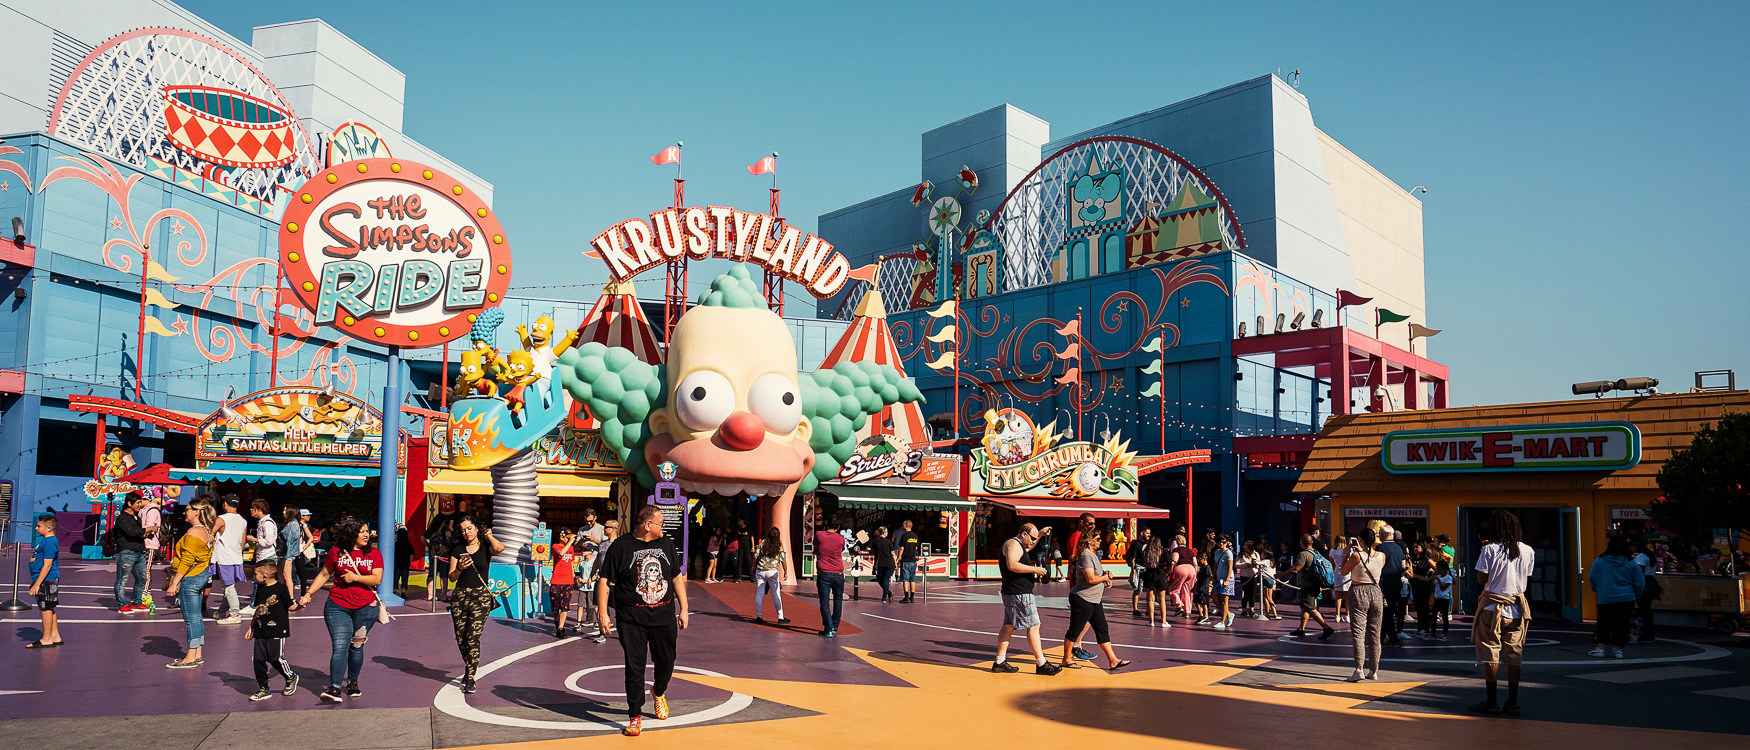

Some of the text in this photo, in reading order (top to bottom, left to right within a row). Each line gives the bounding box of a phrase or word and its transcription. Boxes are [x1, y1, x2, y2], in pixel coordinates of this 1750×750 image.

[667, 147, 677, 161] K
[764, 158, 773, 171] K
[368, 194, 427, 221] THE
[319, 201, 476, 258] SIMPSONS
[590, 205, 851, 299] KRUSTYLAND
[314, 258, 487, 327] RIDE
[232, 438, 368, 456] SANTA'S LITTLE HELPER
[284, 428, 317, 442] HELP
[452, 429, 472, 457] K
[1406, 431, 1609, 468] KWIK-E-MART
[840, 450, 923, 477] Strike 3
[988, 444, 1112, 489] EYE CARUMBA!
